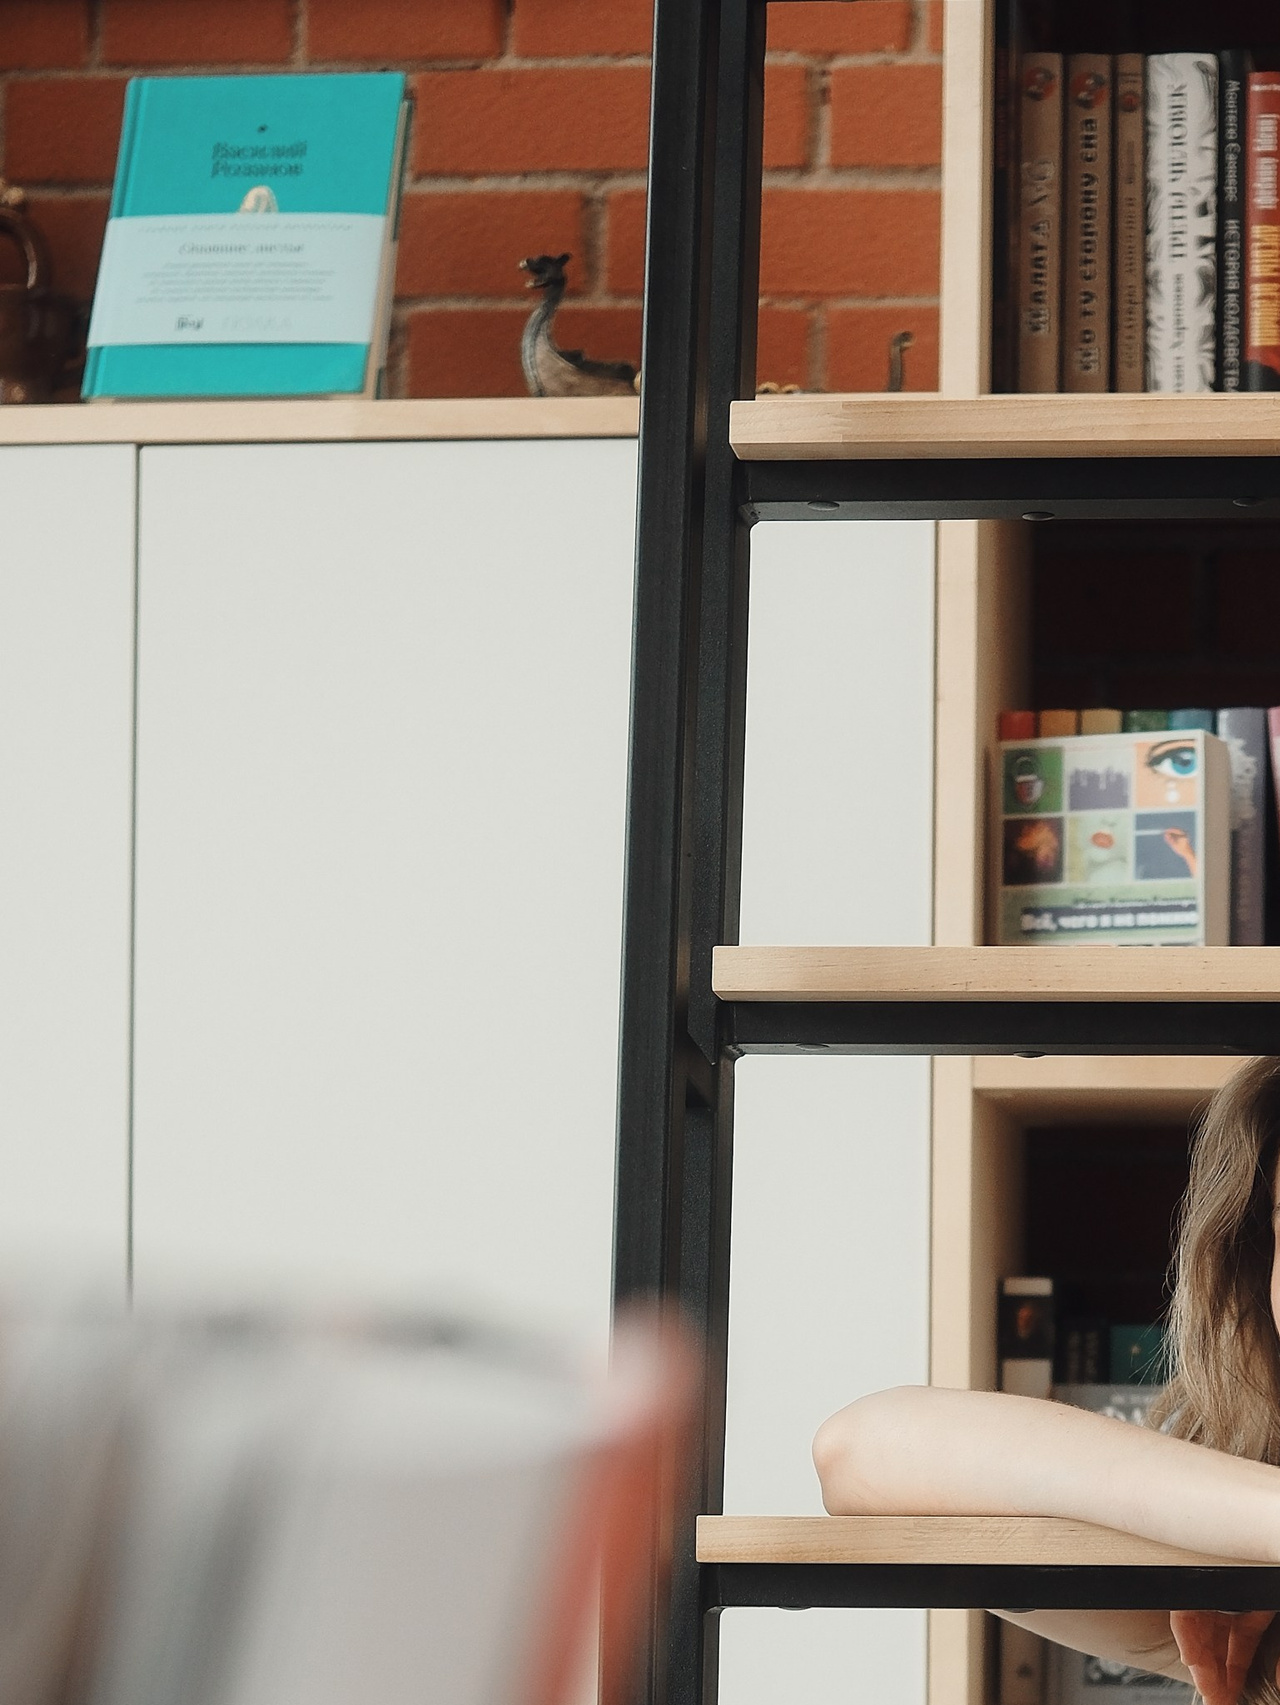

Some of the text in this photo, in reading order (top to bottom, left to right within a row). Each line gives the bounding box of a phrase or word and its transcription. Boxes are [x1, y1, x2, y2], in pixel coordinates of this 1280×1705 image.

[1079, 118, 1099, 164] сна
[1078, 172, 1099, 281] сторону
[1224, 220, 1241, 291] ИСТОРИЯ
[1079, 290, 1099, 318] ту
